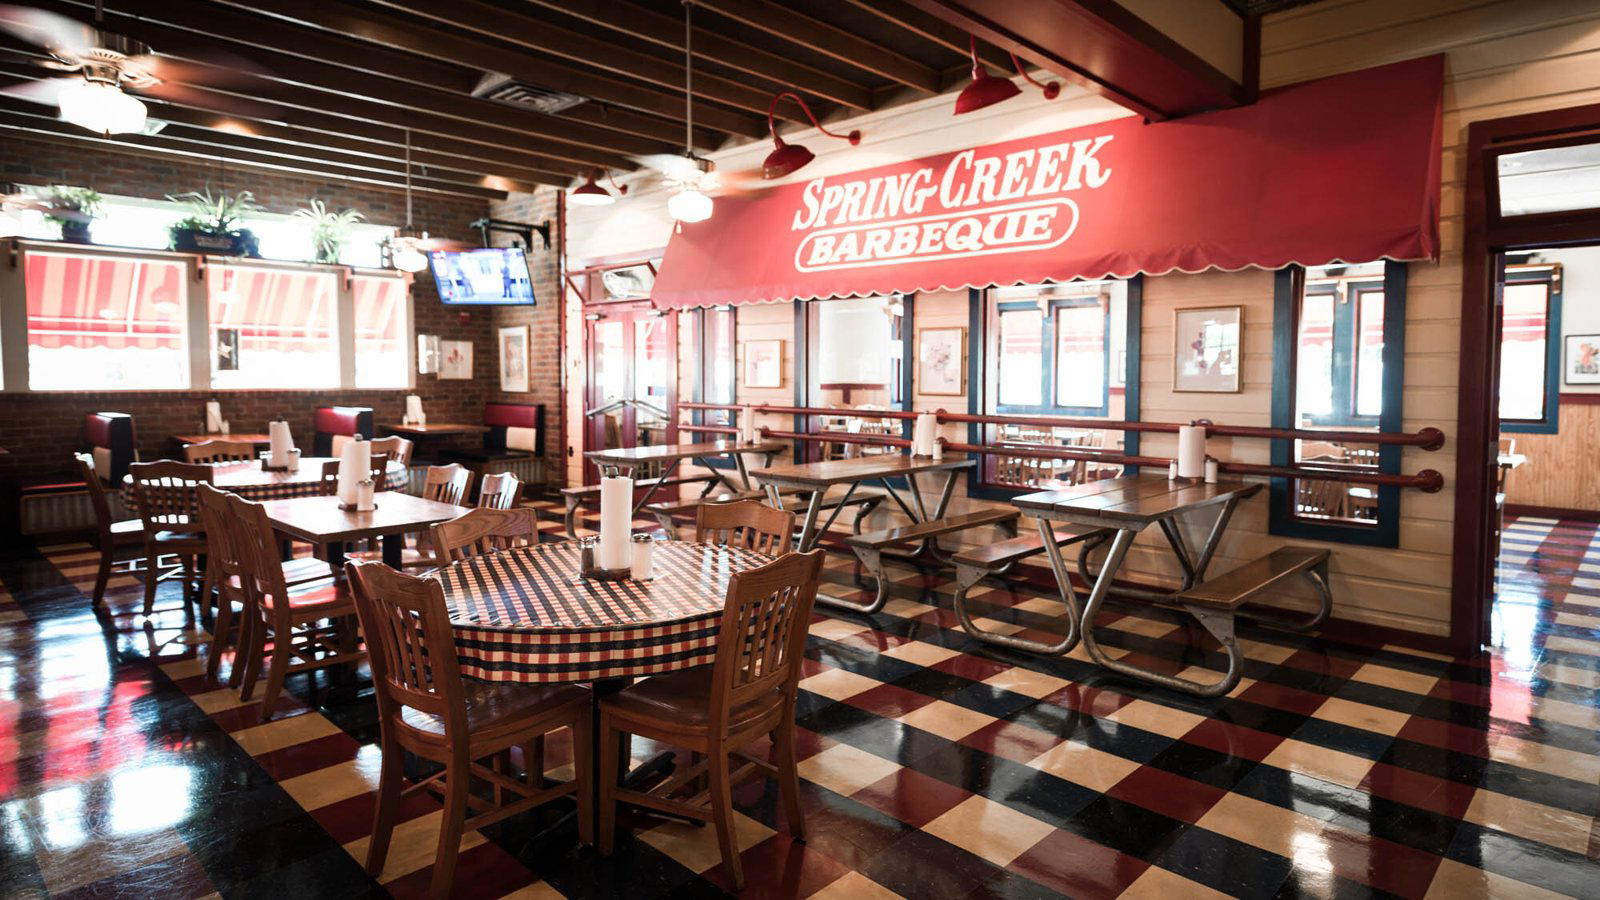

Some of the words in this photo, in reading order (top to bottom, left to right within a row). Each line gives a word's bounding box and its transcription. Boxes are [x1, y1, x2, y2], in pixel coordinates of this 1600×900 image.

[791, 168, 938, 231] SPRING
[939, 135, 1114, 208] CREEK
[807, 207, 1057, 266] BARBEQUE
